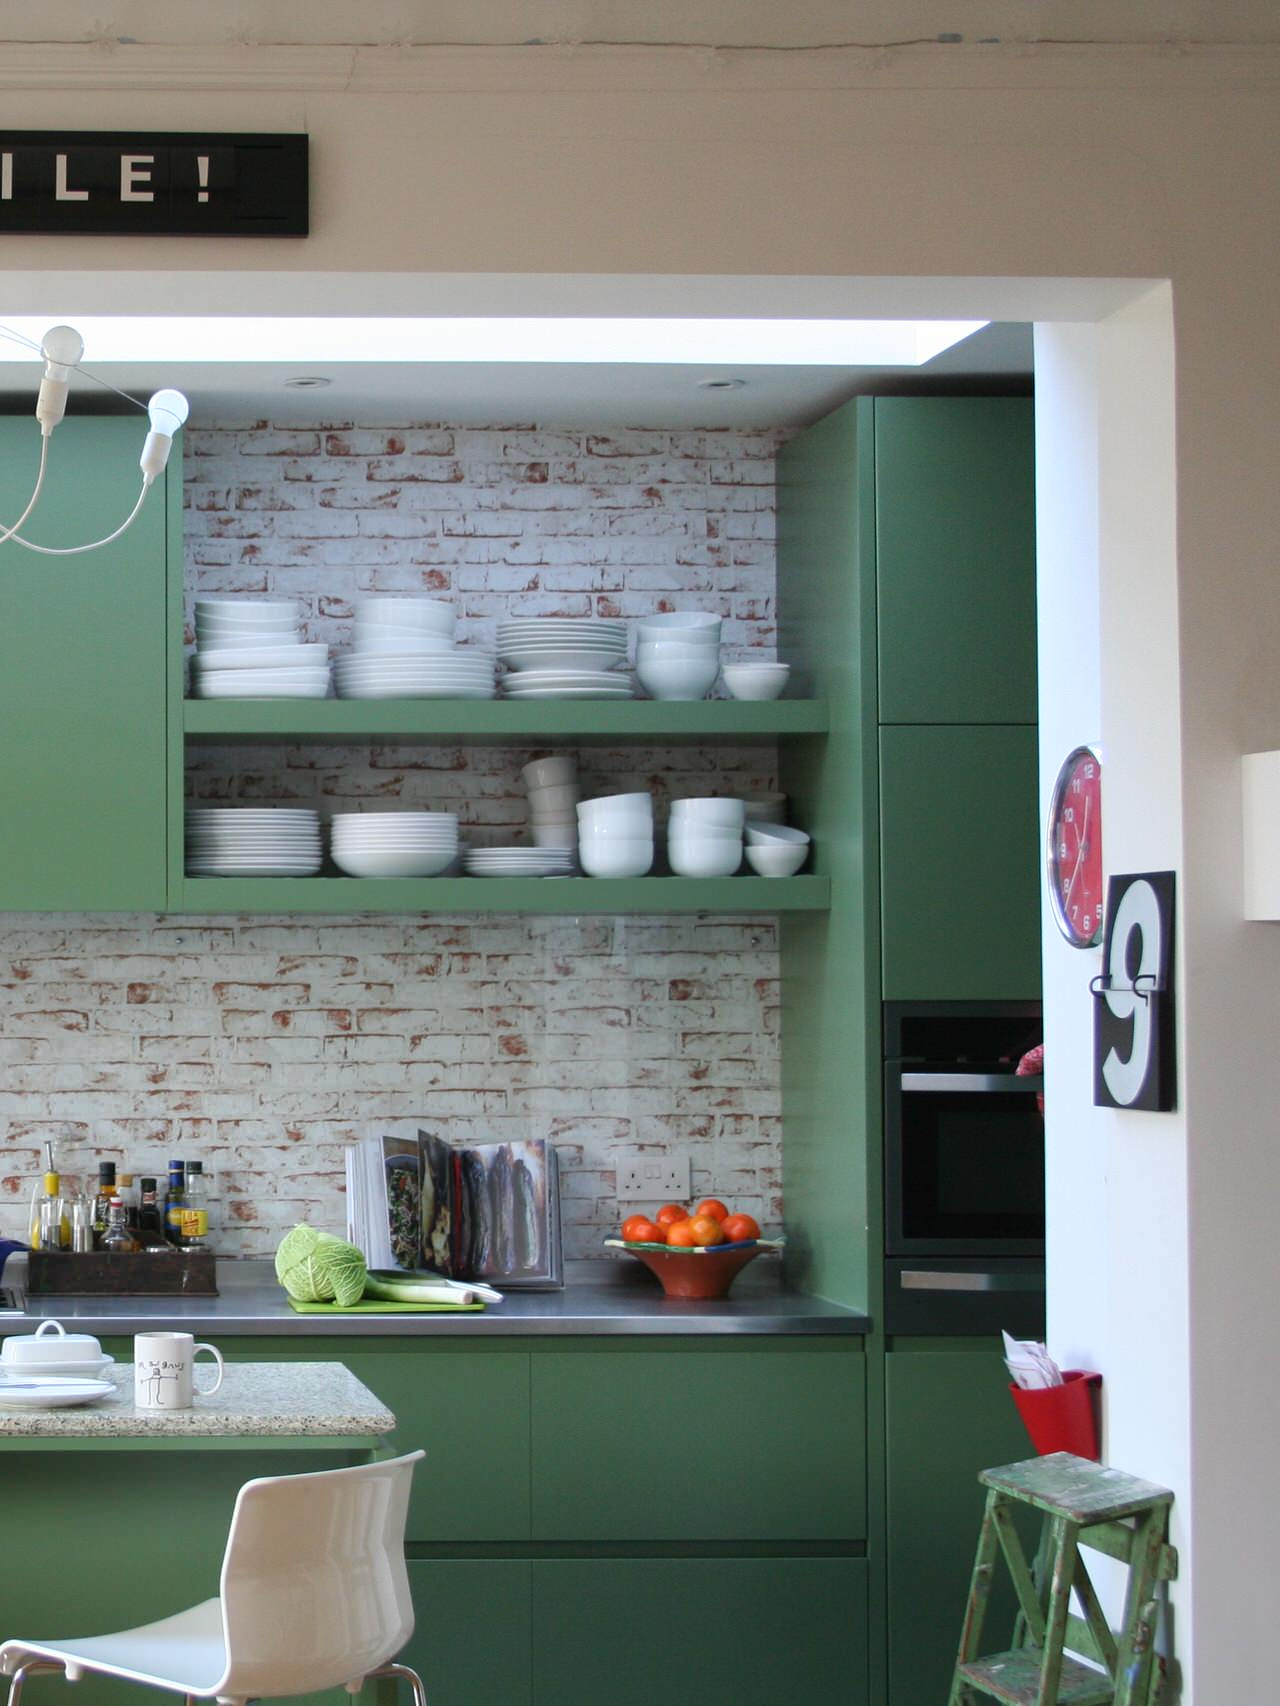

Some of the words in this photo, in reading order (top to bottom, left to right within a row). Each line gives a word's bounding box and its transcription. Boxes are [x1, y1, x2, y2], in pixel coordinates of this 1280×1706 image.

[1083, 763, 1094, 779] 12
[1072, 779, 1081, 793] 11
[1064, 807, 1074, 823] 10
[1060, 842, 1067, 858] 9
[1063, 878, 1070, 894] 8
[1072, 905, 1079, 921] 7
[1083, 915, 1090, 930] 6
[1102, 879, 1161, 1105] 9
